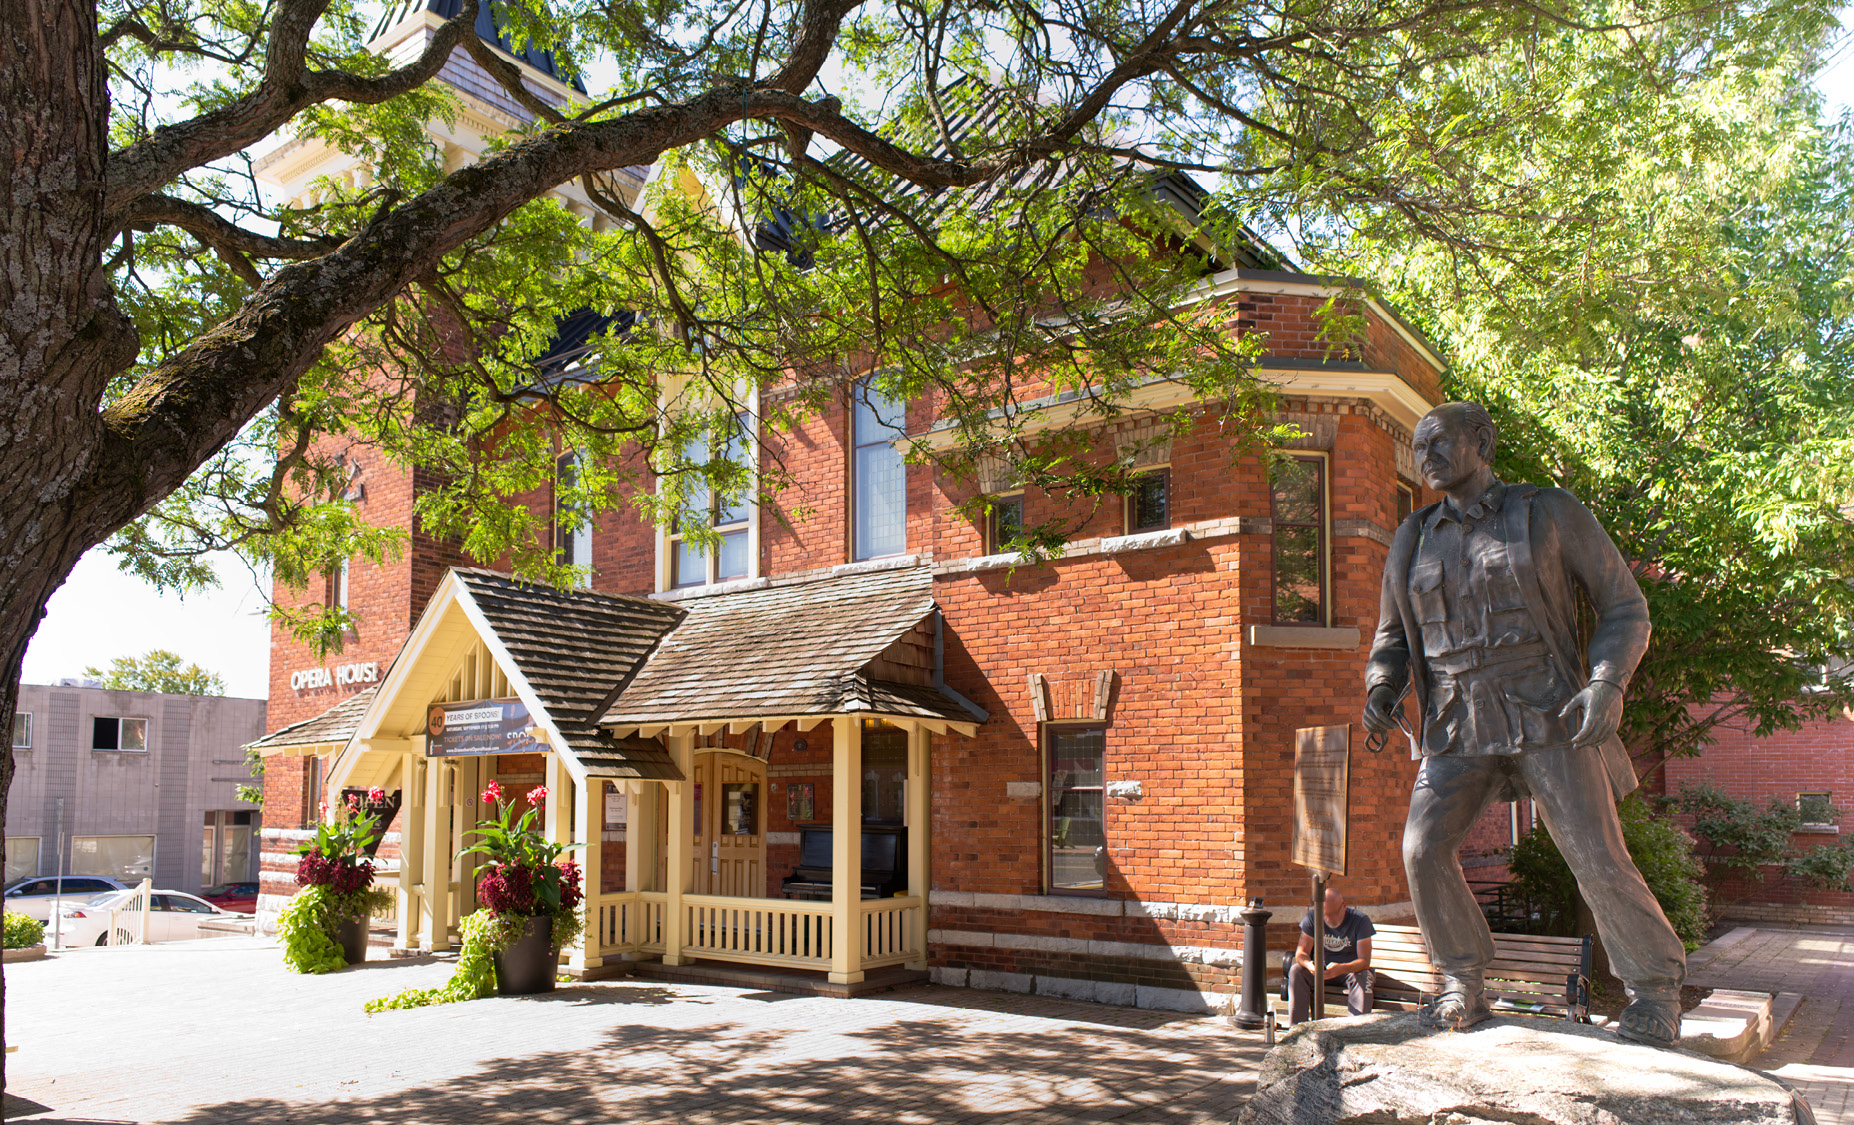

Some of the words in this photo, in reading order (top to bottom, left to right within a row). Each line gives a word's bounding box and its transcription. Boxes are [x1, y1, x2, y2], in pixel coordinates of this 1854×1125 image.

[291, 667, 332, 690] OPERA
[337, 662, 378, 684] HOUSE
[431, 716, 442, 728] 40
[447, 713, 464, 722] YEARS
[465, 712, 473, 720] OF
[475, 711, 499, 719] SPOONS!
[444, 735, 464, 743] TICKETS
[473, 734, 487, 742] SALE
[487, 733, 502, 741] NOW!
